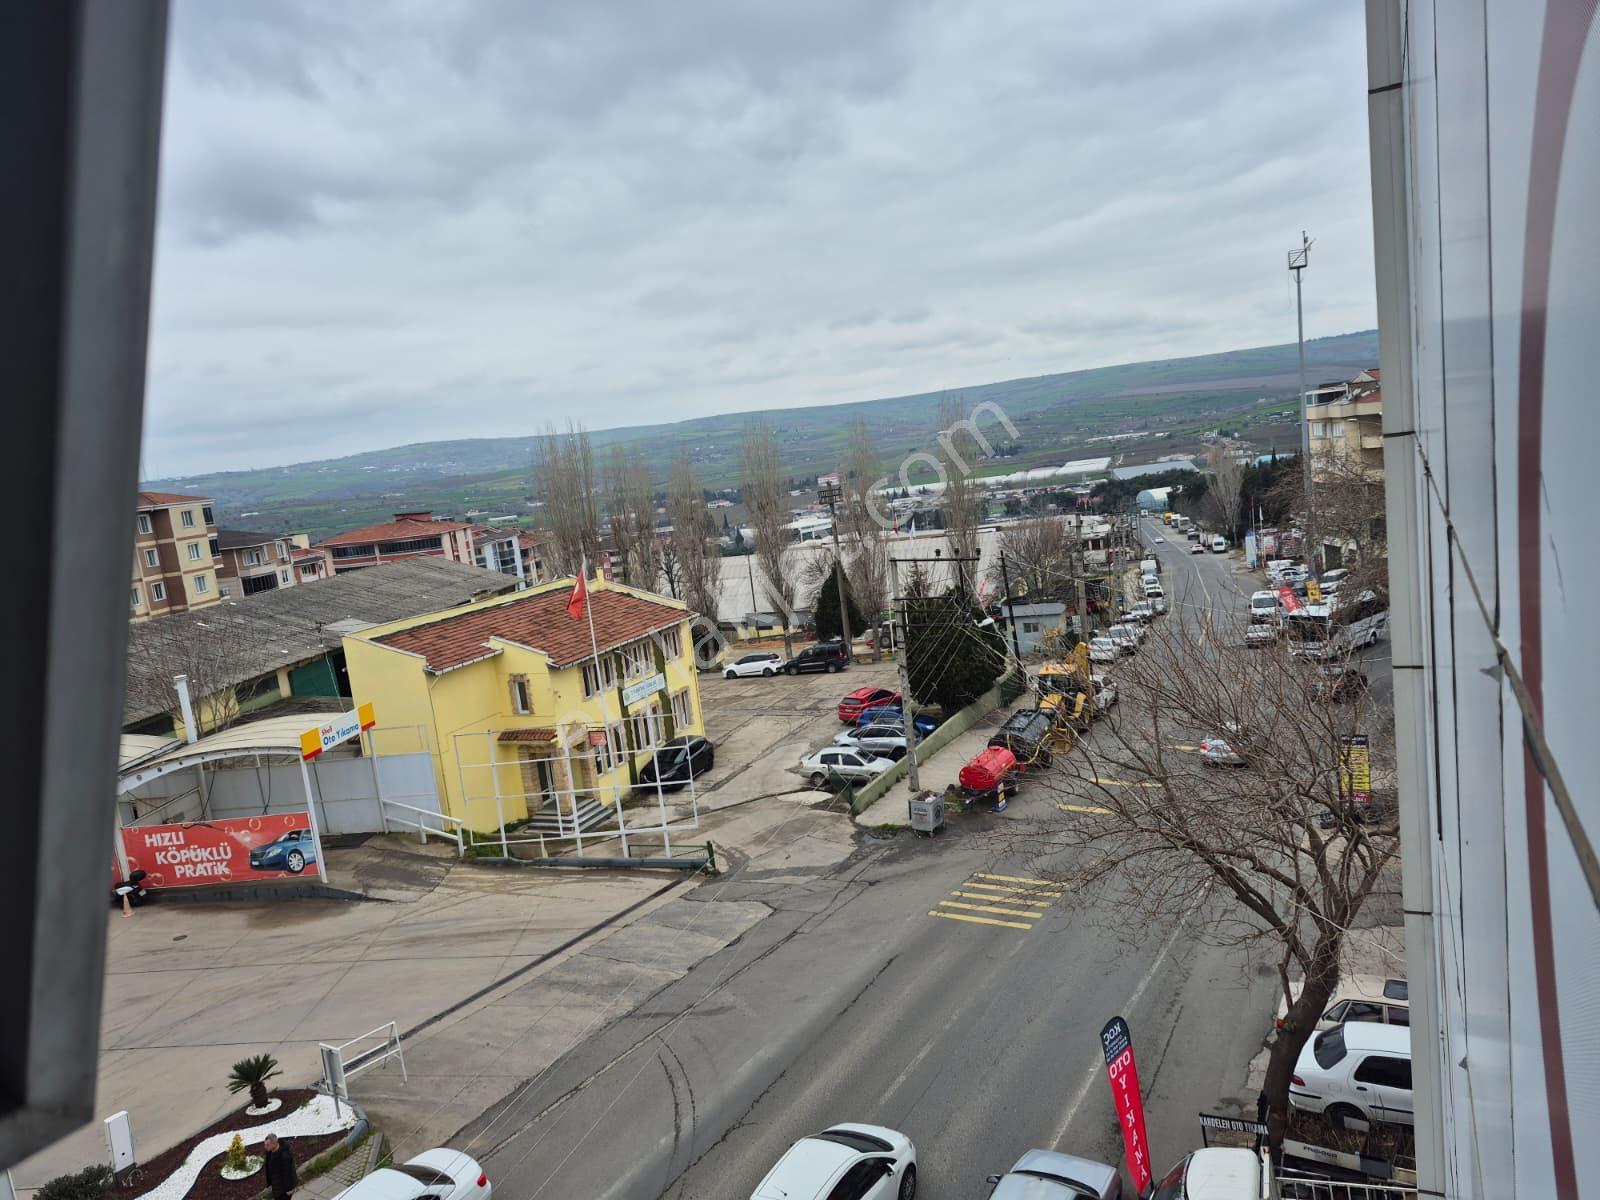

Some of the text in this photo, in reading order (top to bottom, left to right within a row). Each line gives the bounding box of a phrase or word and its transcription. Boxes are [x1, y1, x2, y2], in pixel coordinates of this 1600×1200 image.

[323, 735, 336, 746] Oto
[144, 831, 185, 848] HIZLI
[155, 842, 232, 865] KÖPÜKLÜ
[1231, 1120, 1245, 1131] OTO
